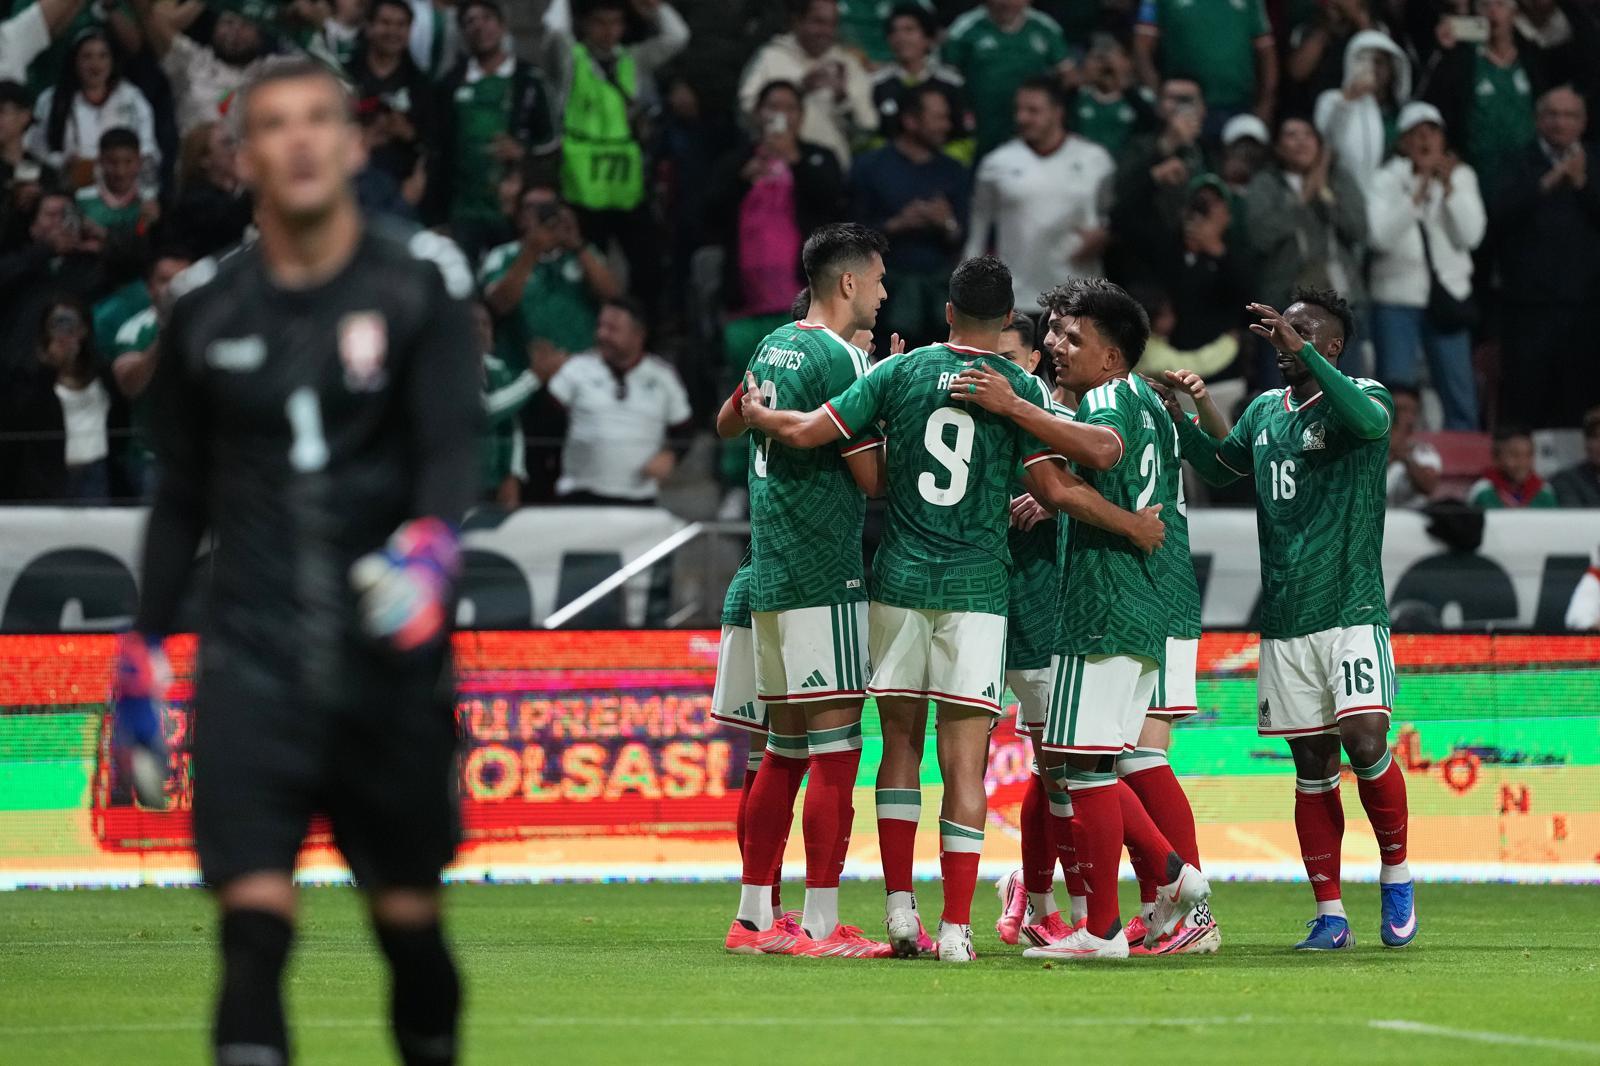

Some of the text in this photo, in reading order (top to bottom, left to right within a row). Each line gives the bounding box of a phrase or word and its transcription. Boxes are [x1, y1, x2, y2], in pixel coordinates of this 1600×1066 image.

[286, 387, 330, 473] 1
[918, 407, 975, 506] 9
[1270, 460, 1296, 500] 16
[1341, 657, 1375, 697] 16
[464, 740, 731, 802] OLSAS!
